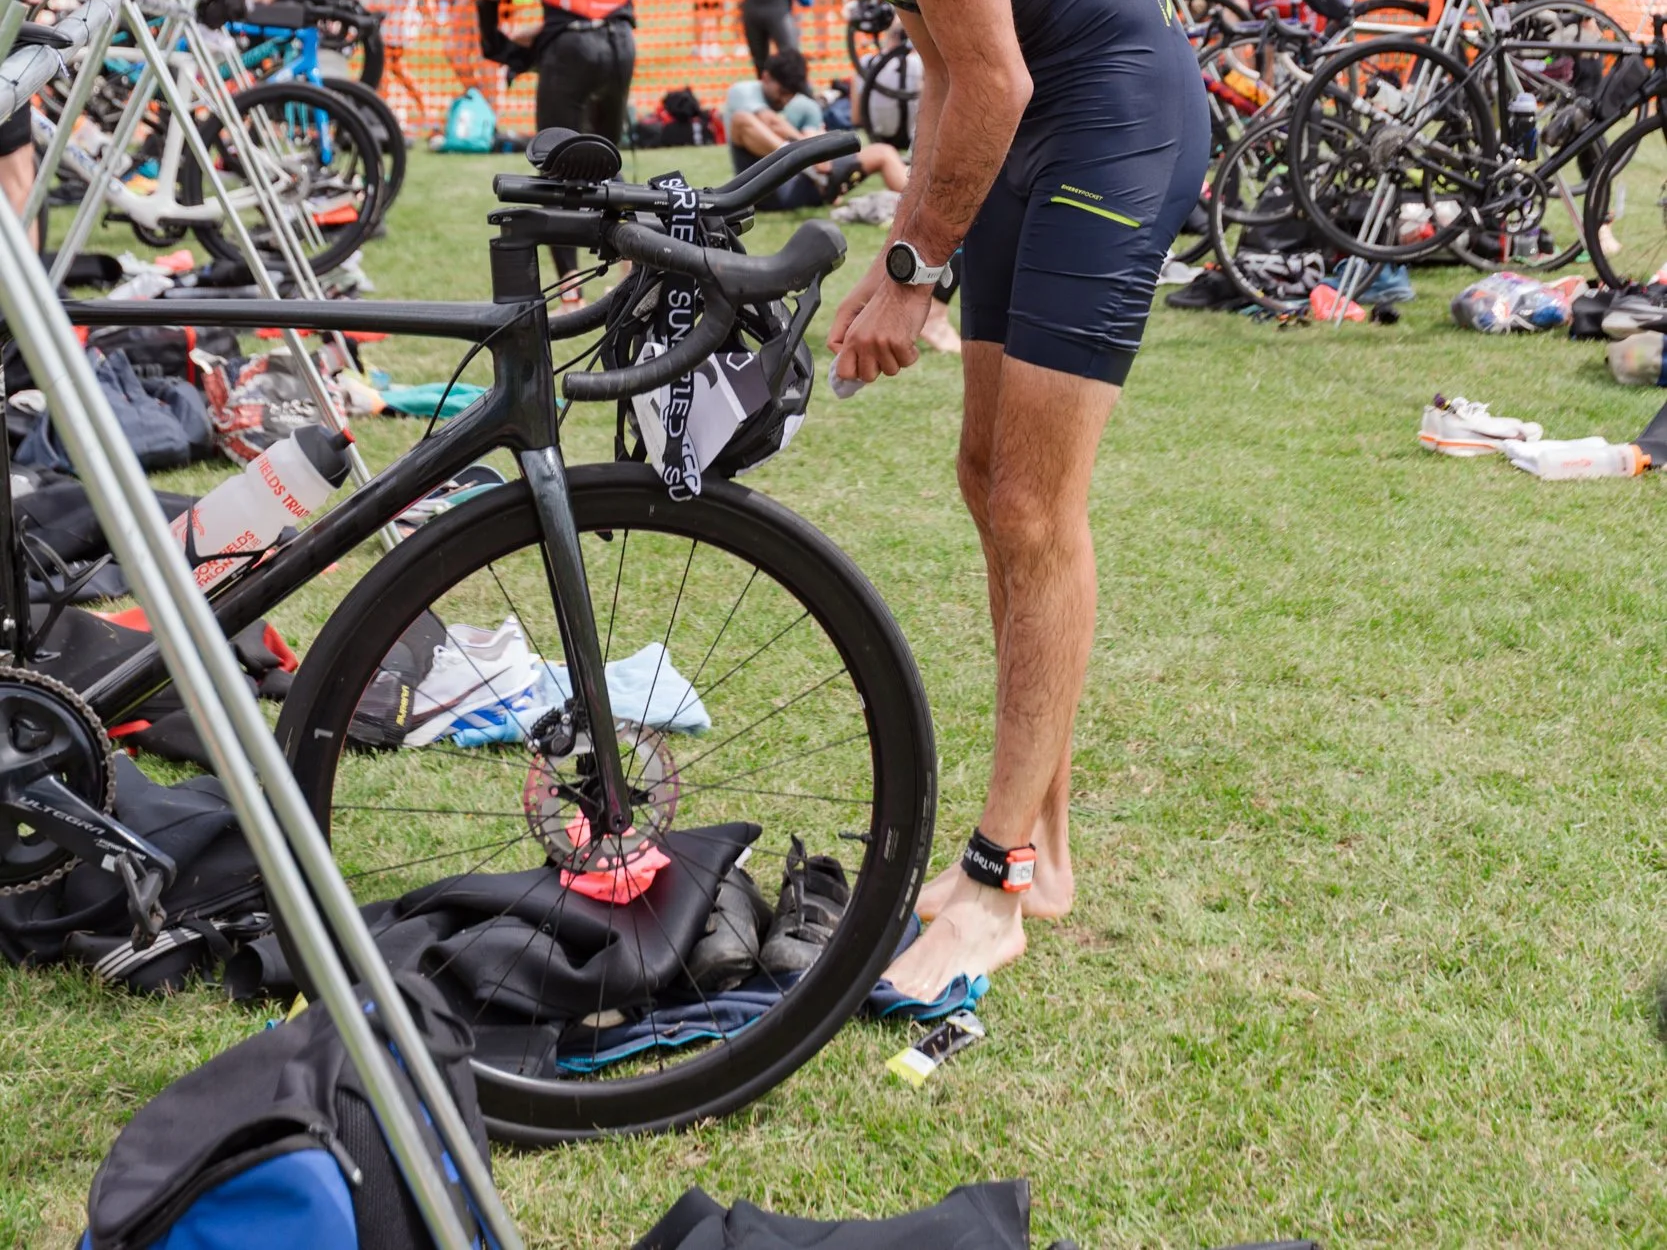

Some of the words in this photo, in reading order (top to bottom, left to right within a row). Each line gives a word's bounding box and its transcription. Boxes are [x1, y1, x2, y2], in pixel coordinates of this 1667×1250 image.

[1061, 184, 1103, 201] ENERGYPOCKET
[18, 796, 106, 835] ULTEGRA
[972, 851, 1004, 876] HuTag
